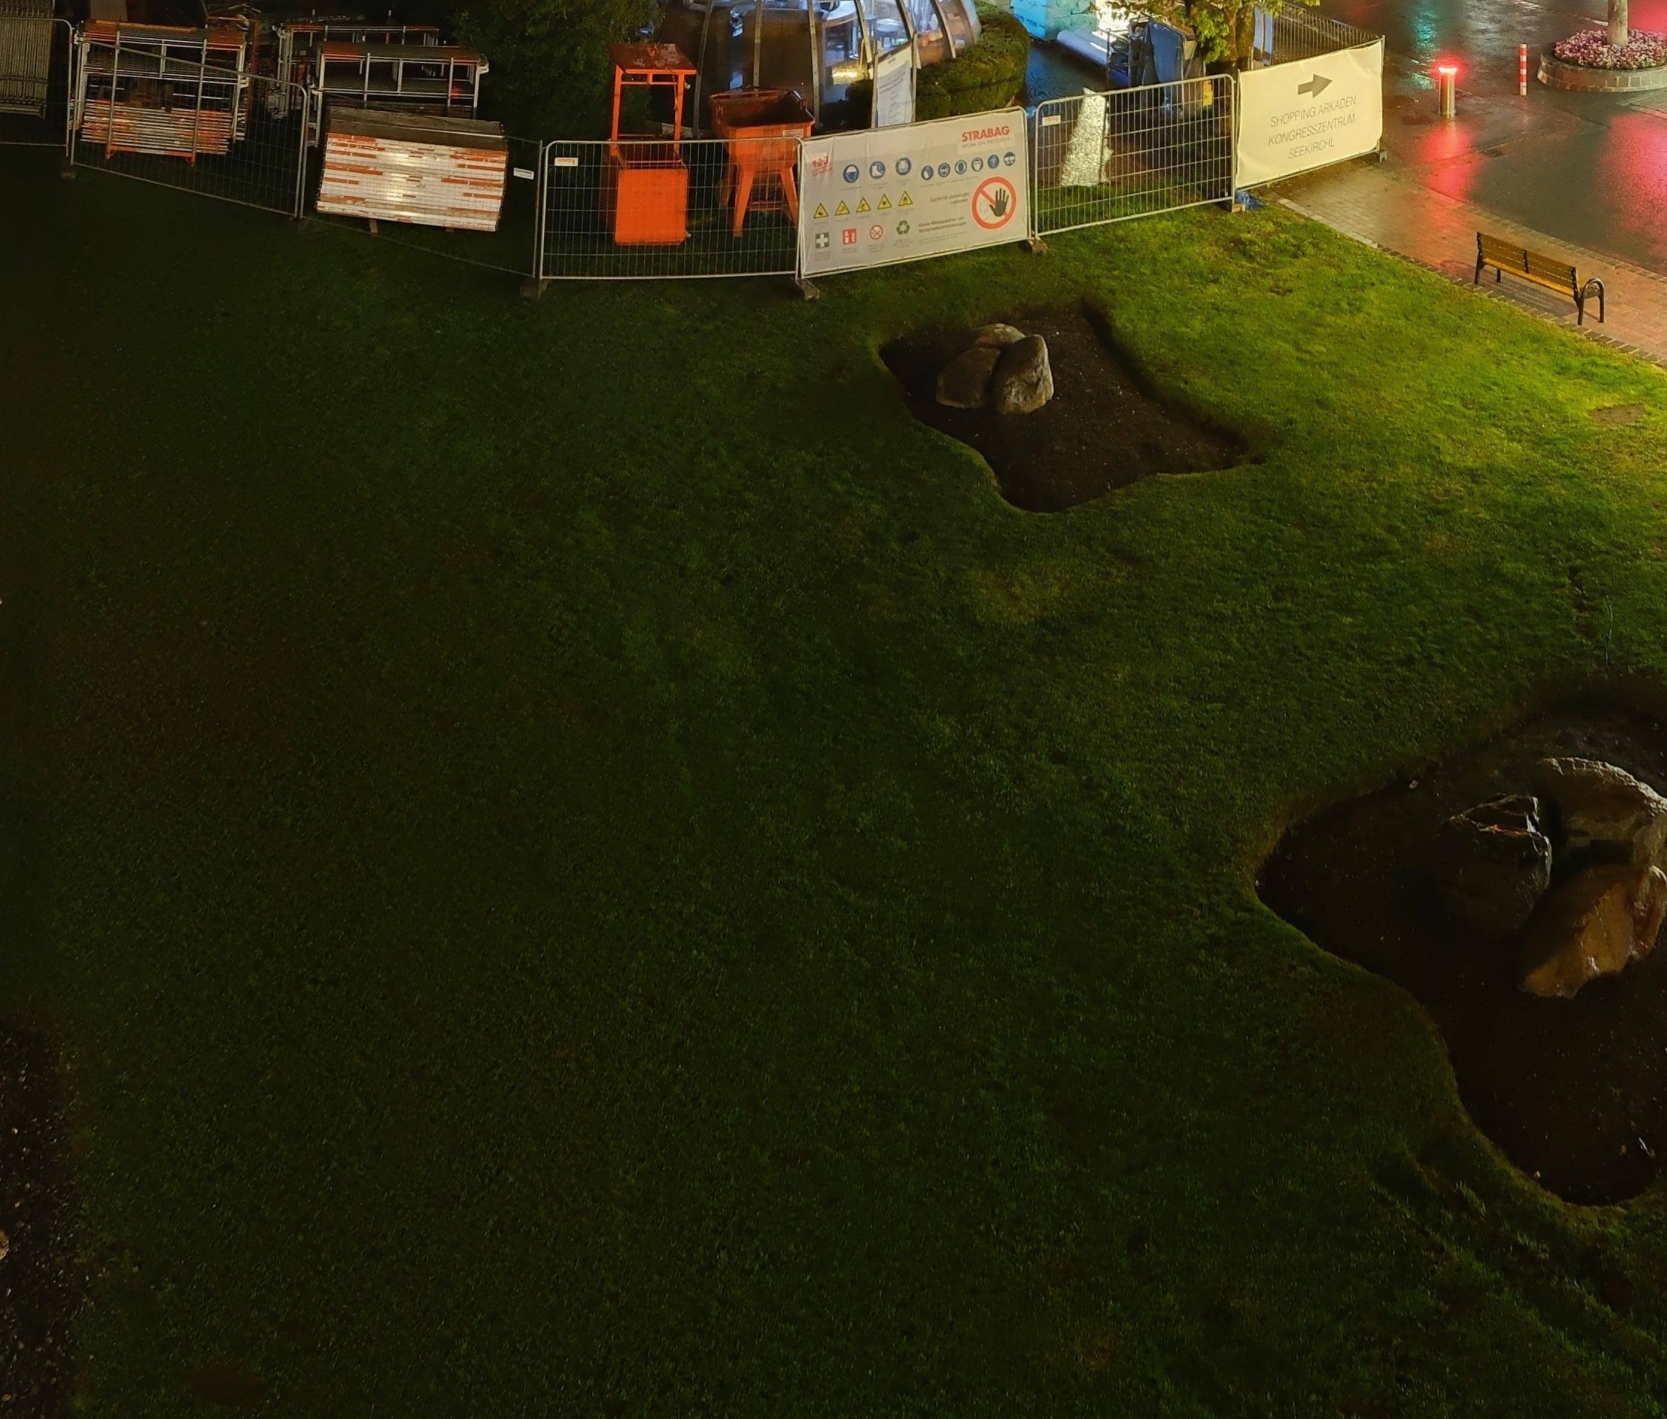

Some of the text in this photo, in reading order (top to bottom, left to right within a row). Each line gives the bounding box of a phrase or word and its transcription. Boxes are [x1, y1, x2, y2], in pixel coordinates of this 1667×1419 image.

[1269, 95, 1357, 128] SHOPPING ARKADEN
[961, 125, 1010, 142] STRABAG
[1268, 112, 1356, 146] KONGRESSZENTRUM
[1287, 137, 1335, 160] SEEKIRCHL
